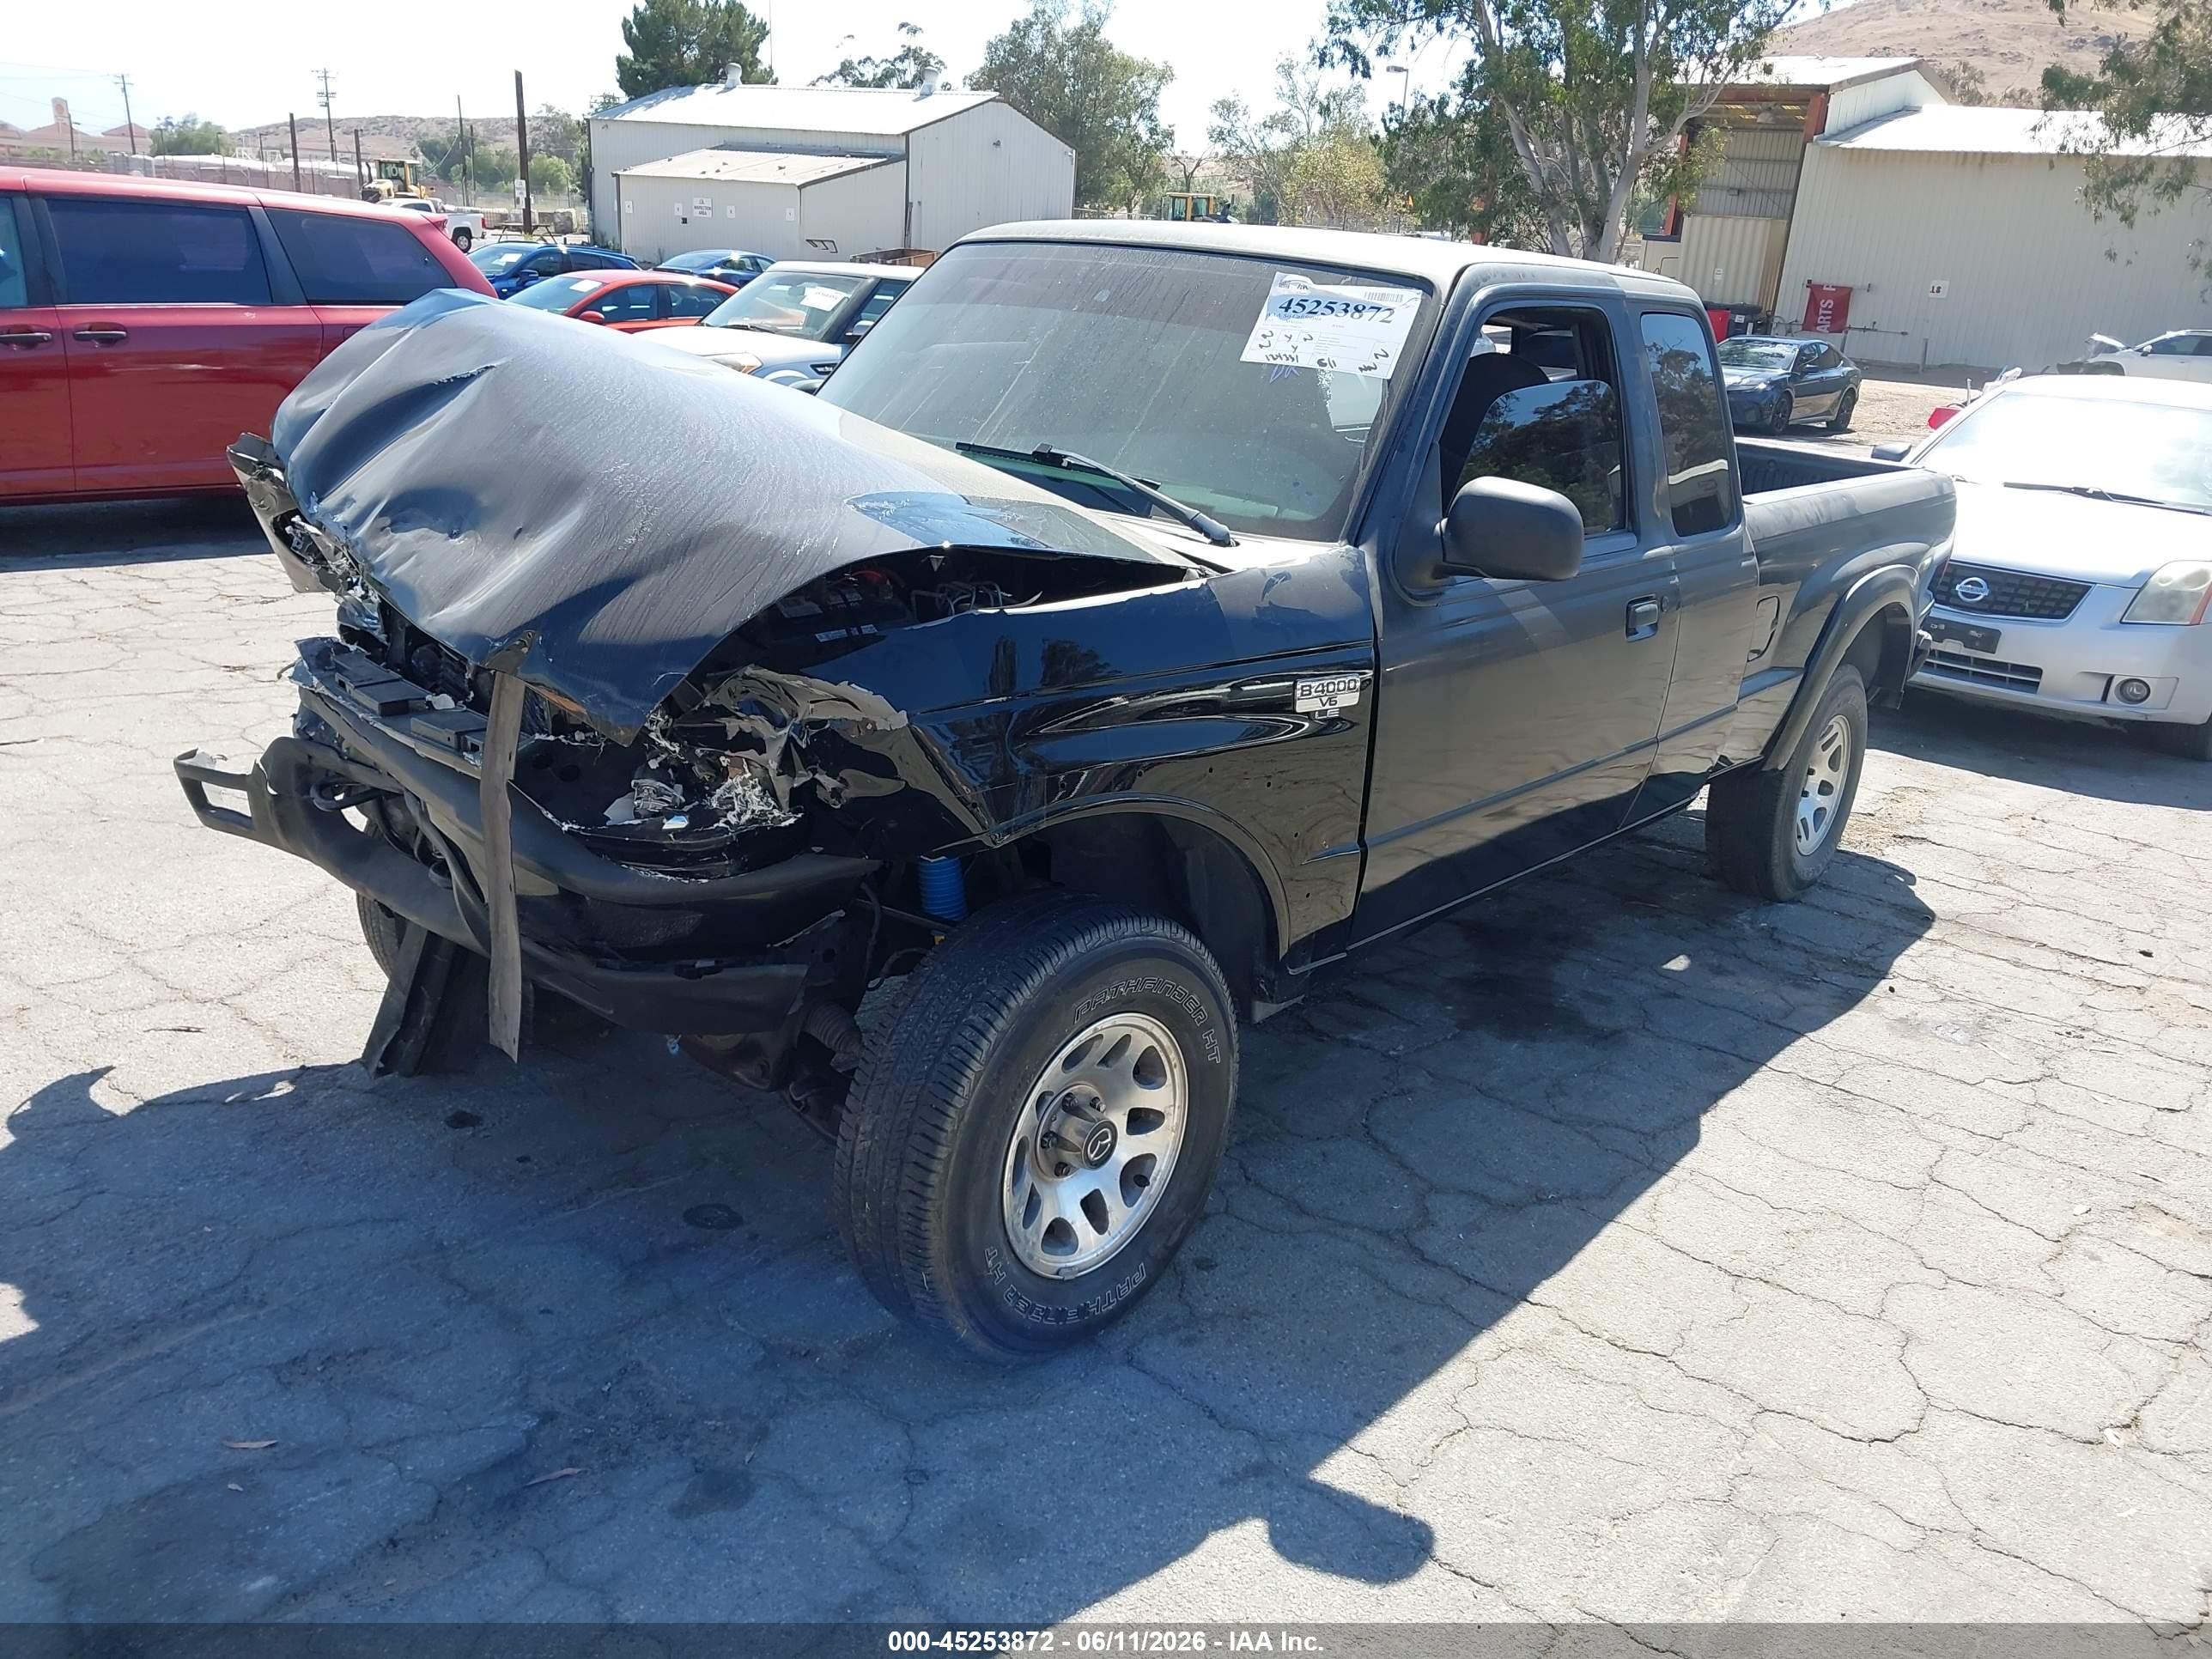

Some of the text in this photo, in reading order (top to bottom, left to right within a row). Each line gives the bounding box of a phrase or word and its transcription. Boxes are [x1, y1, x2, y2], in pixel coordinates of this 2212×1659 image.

[1278, 297, 1395, 324] 45253872
[1319, 696, 1338, 707] V6
[1074, 975, 1221, 1064] PATHFINDER HT
